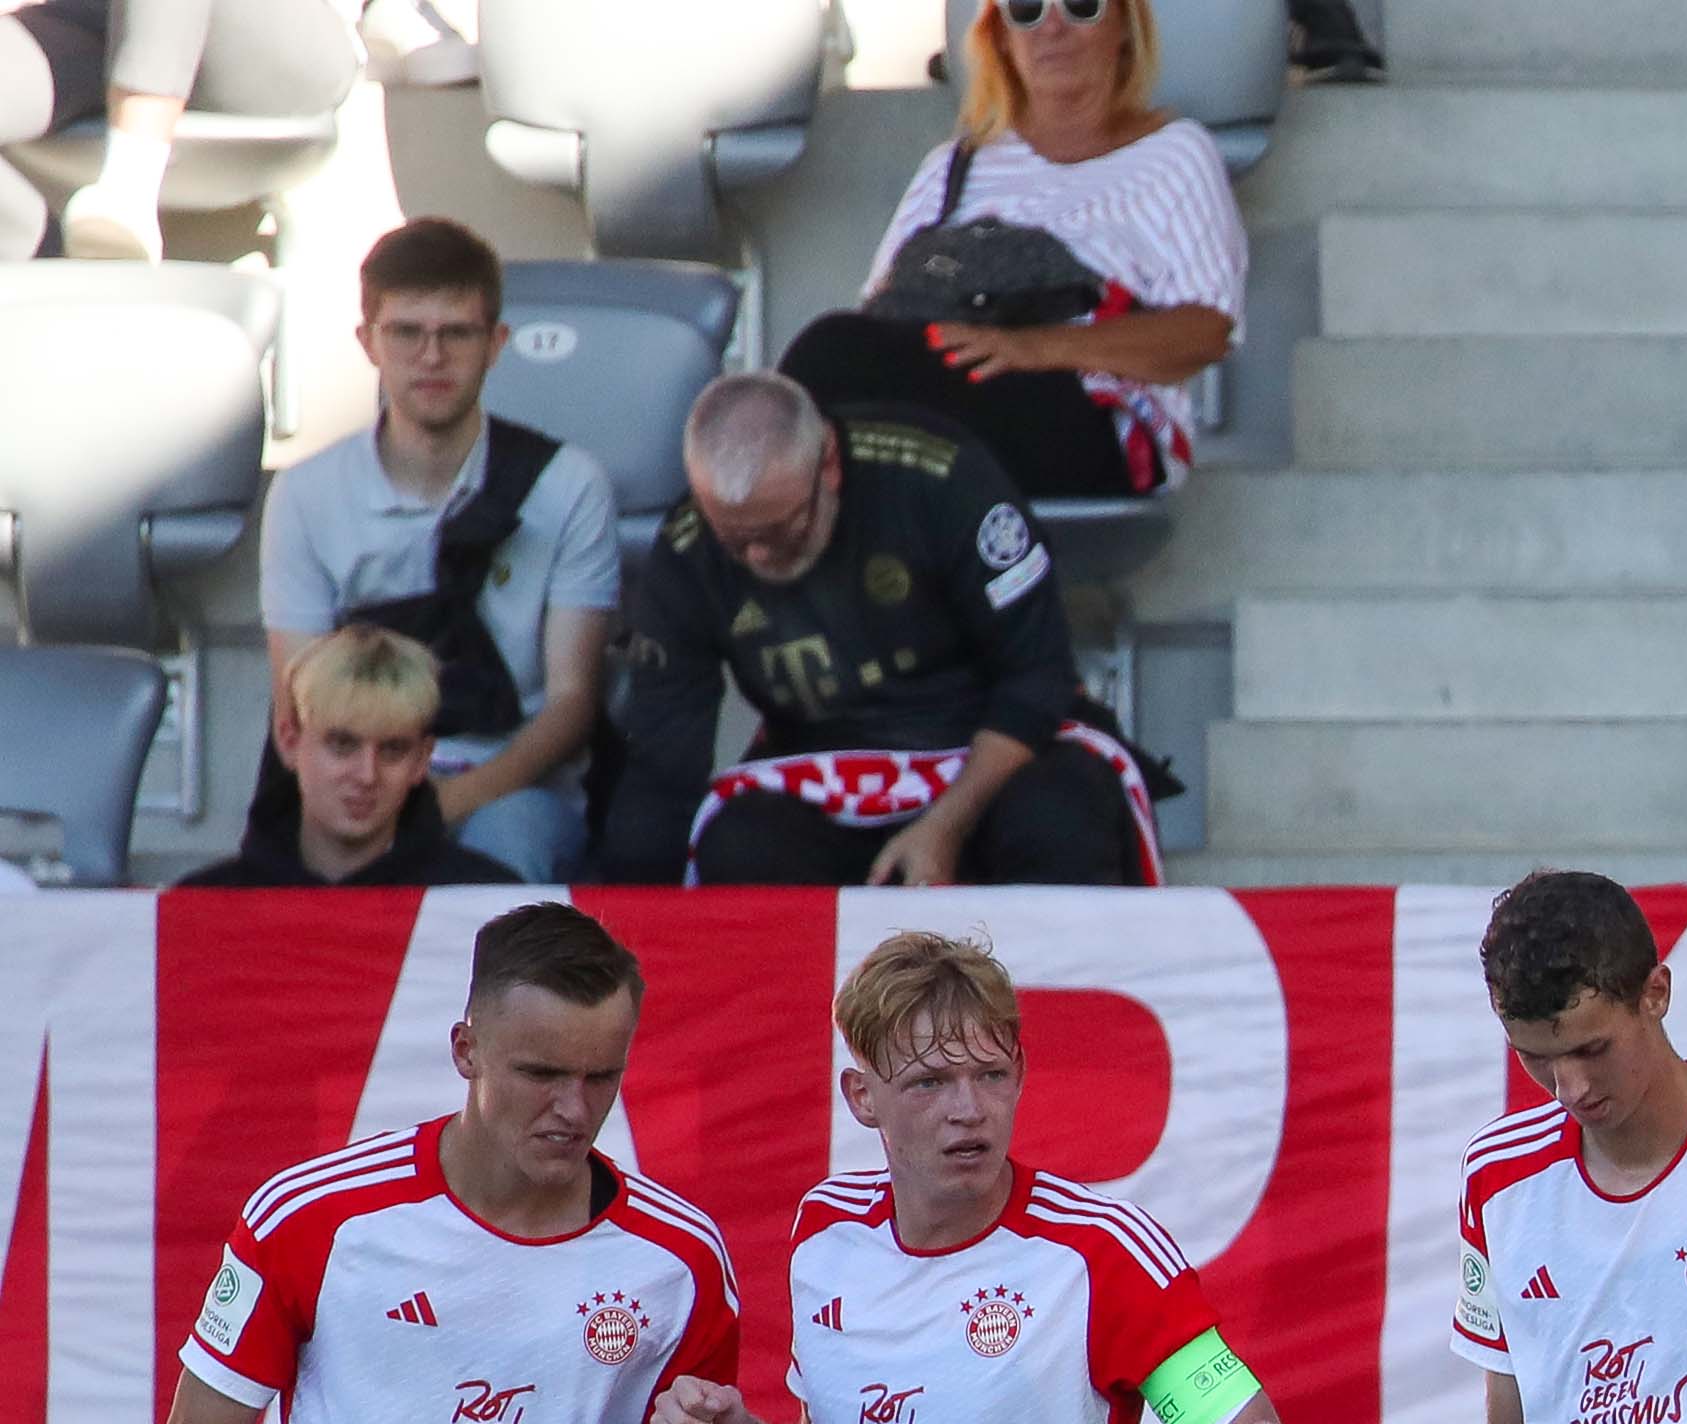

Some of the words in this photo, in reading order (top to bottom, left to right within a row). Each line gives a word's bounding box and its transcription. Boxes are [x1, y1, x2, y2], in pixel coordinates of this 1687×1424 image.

[1580, 1336, 1654, 1386] ROT
[451, 1379, 536, 1424] ROT
[1580, 1360, 1645, 1413] GEGEN
